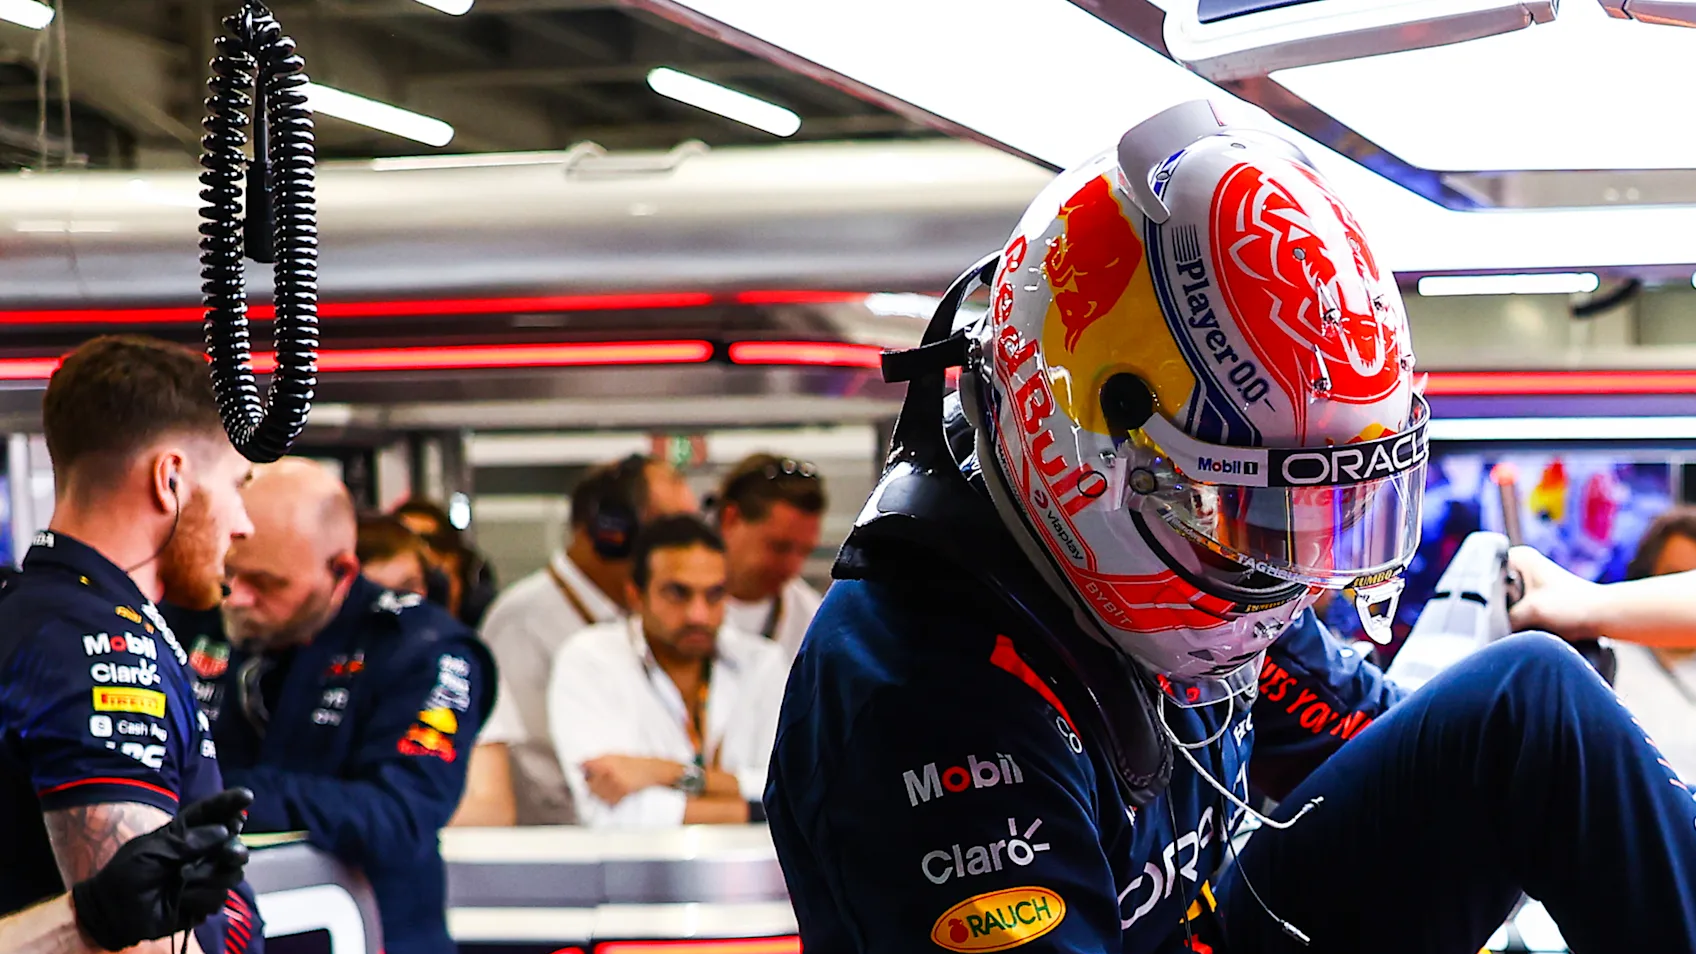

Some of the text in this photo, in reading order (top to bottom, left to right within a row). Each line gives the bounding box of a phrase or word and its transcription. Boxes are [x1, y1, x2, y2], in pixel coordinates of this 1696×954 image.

[1177, 258, 1239, 364] Player
[1197, 456, 1241, 474] Mobil
[1048, 510, 1084, 561] viaplay
[1084, 582, 1132, 626] BYBIT
[83, 631, 157, 660] Mobil
[90, 661, 157, 686] Claro
[903, 752, 1024, 807] Mobil
[921, 829, 1046, 885] Claro
[966, 895, 1052, 939] RAUCH
